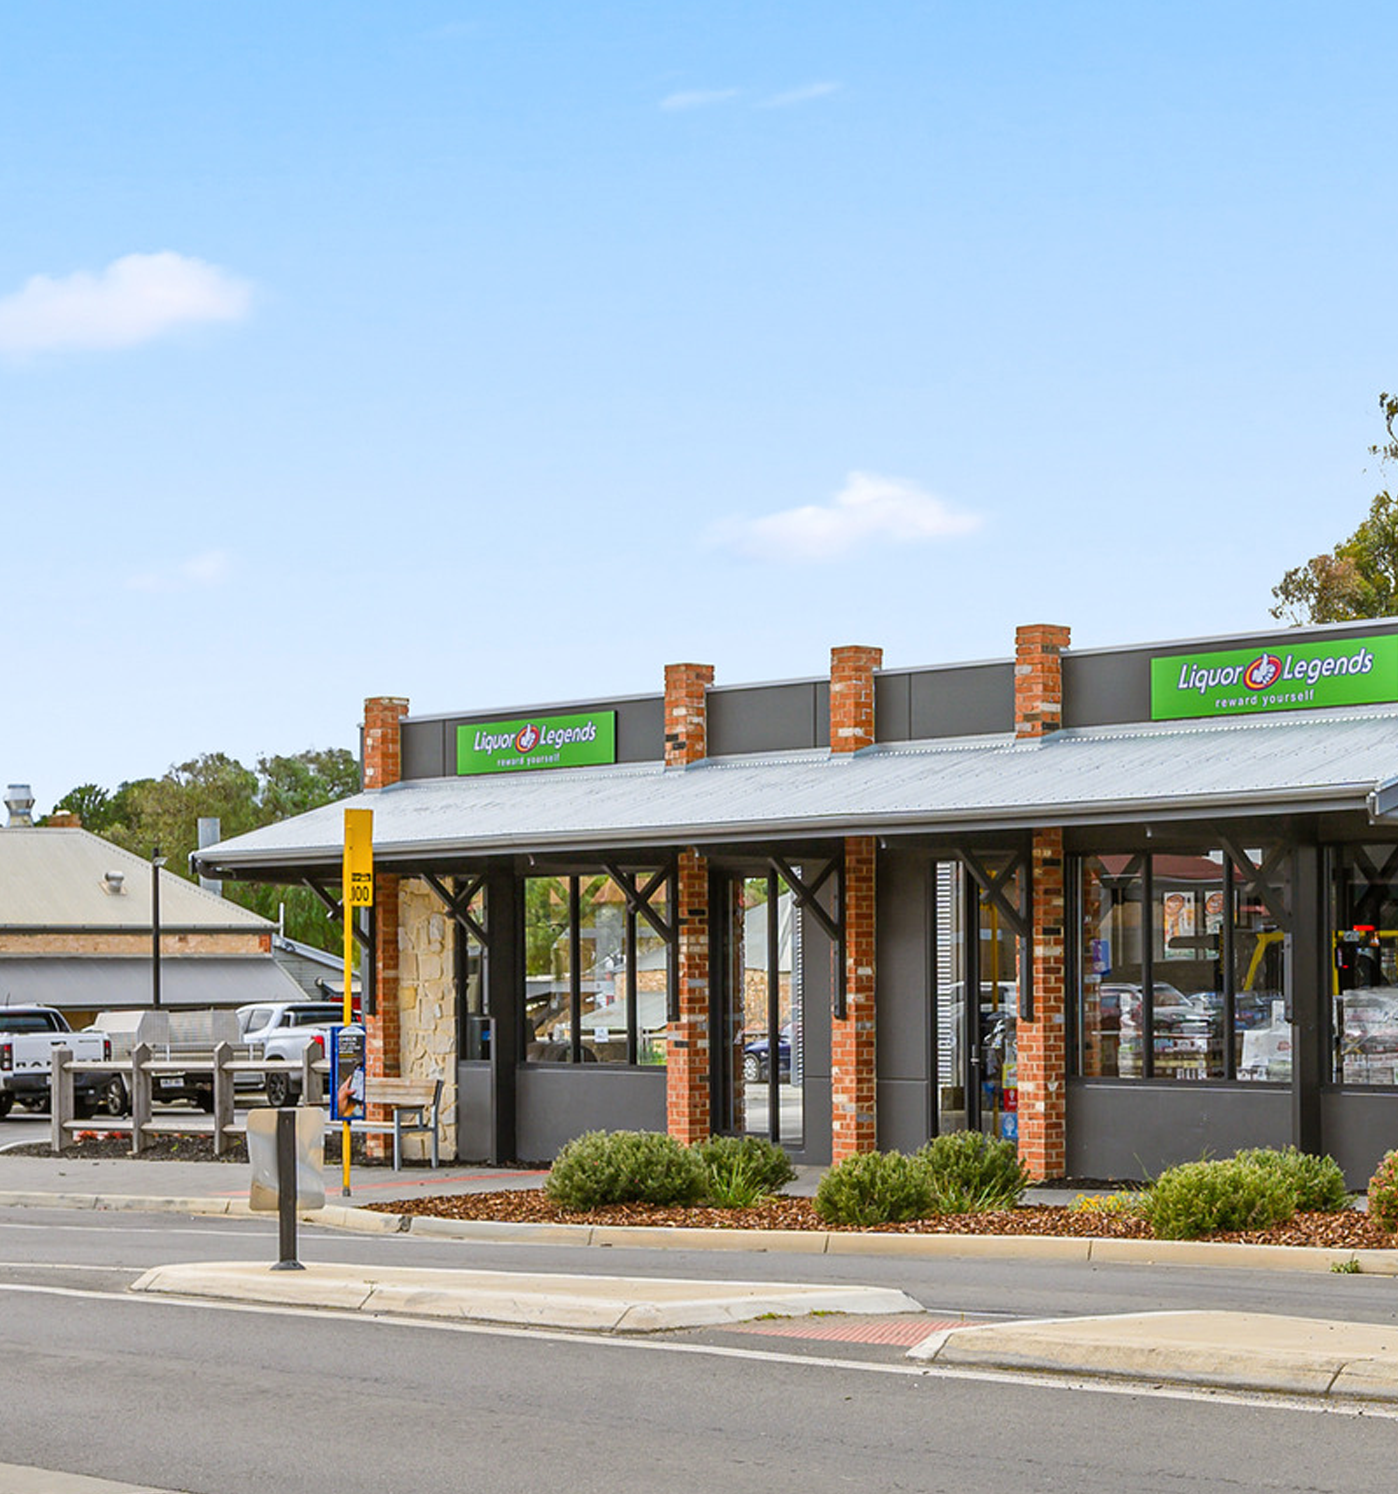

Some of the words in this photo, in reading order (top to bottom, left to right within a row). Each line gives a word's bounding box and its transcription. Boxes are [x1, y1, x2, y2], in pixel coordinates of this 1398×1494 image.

[1177, 663, 1244, 694] Liquor
[1283, 648, 1374, 685] Legends
[1215, 694, 1258, 709] reward
[1262, 689, 1315, 708] yourself
[473, 730, 516, 755] Liquor
[539, 720, 597, 749] Legends
[497, 756, 524, 767] reward
[527, 753, 560, 767] yourself
